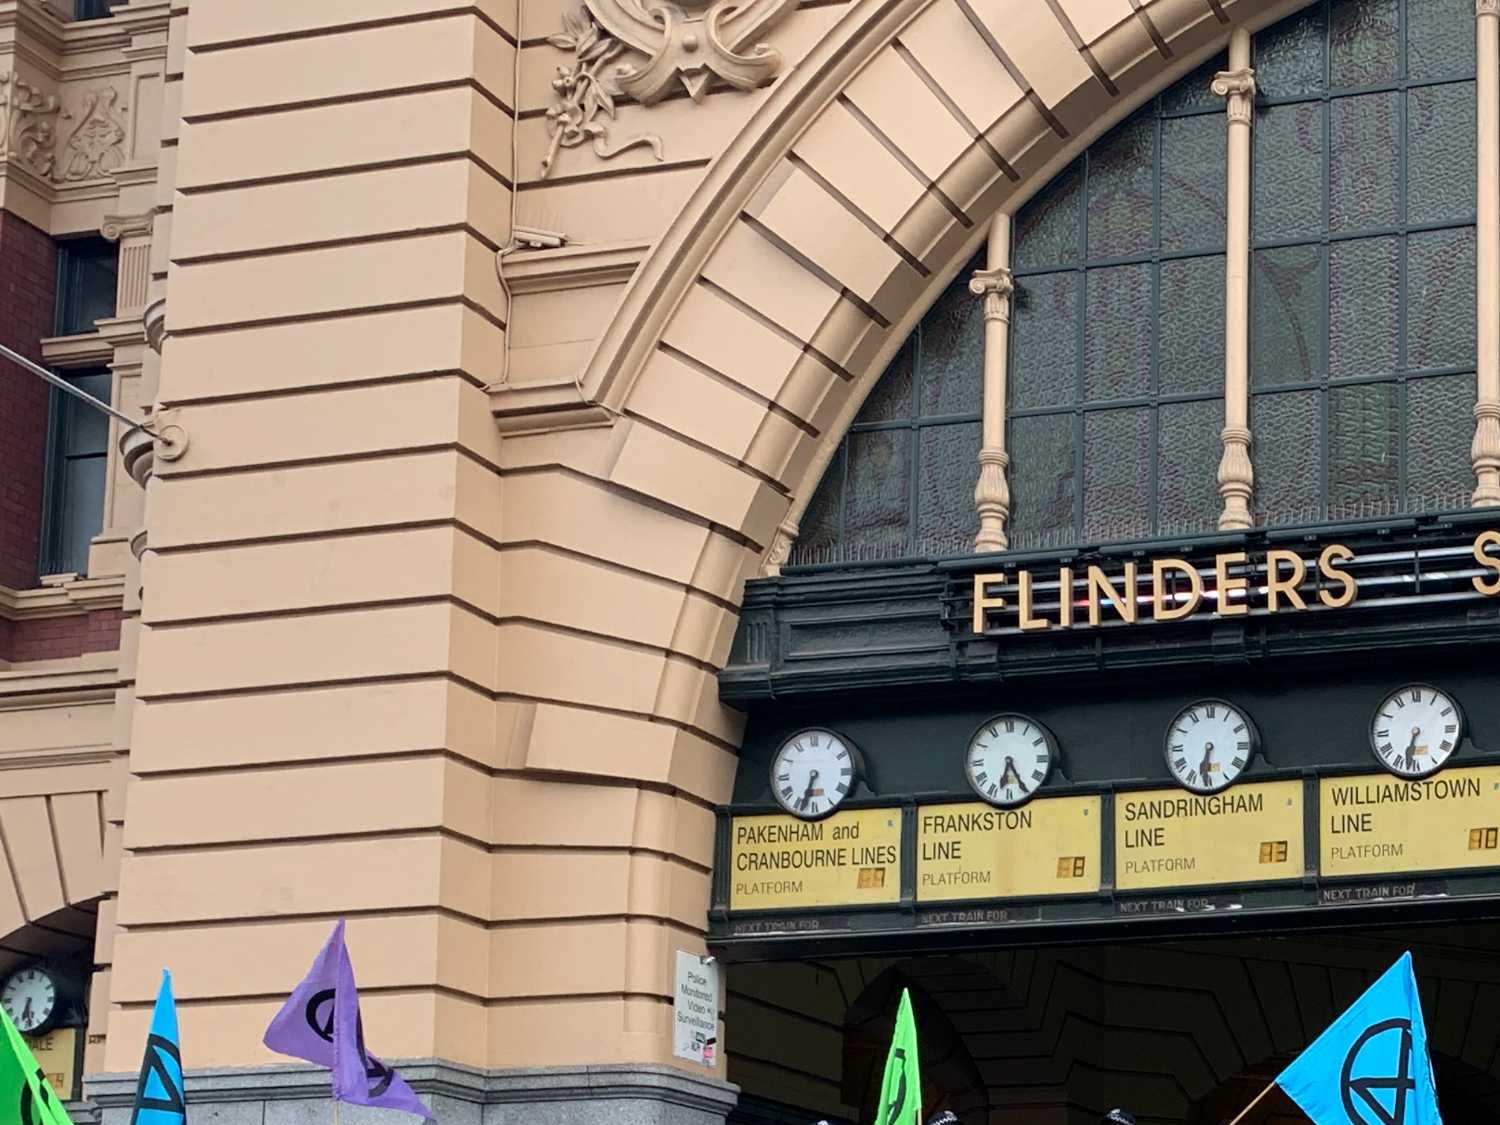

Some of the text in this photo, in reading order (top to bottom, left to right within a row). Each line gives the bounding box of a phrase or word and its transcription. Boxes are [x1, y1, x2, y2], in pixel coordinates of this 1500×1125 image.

[972, 543, 1358, 635] FLINDERS
[1332, 778, 1480, 806] WILLIAMSTOWN
[1125, 794, 1263, 821] SANDRINGHAM
[923, 810, 1032, 834] FRANKSTON
[1331, 813, 1372, 833] LINE
[737, 821, 860, 844] PAKENHAM and
[1125, 828, 1165, 848] LINE
[737, 846, 896, 871] CRANBOURNE LINES
[923, 841, 961, 861] LINE
[1331, 843, 1403, 859] PLATFORM
[1125, 857, 1195, 873] PLATFORM
[736, 881, 803, 895] PLATFORM
[922, 871, 991, 886] PLATFORM
[1322, 884, 1415, 900] NEXT TRAIN FOR
